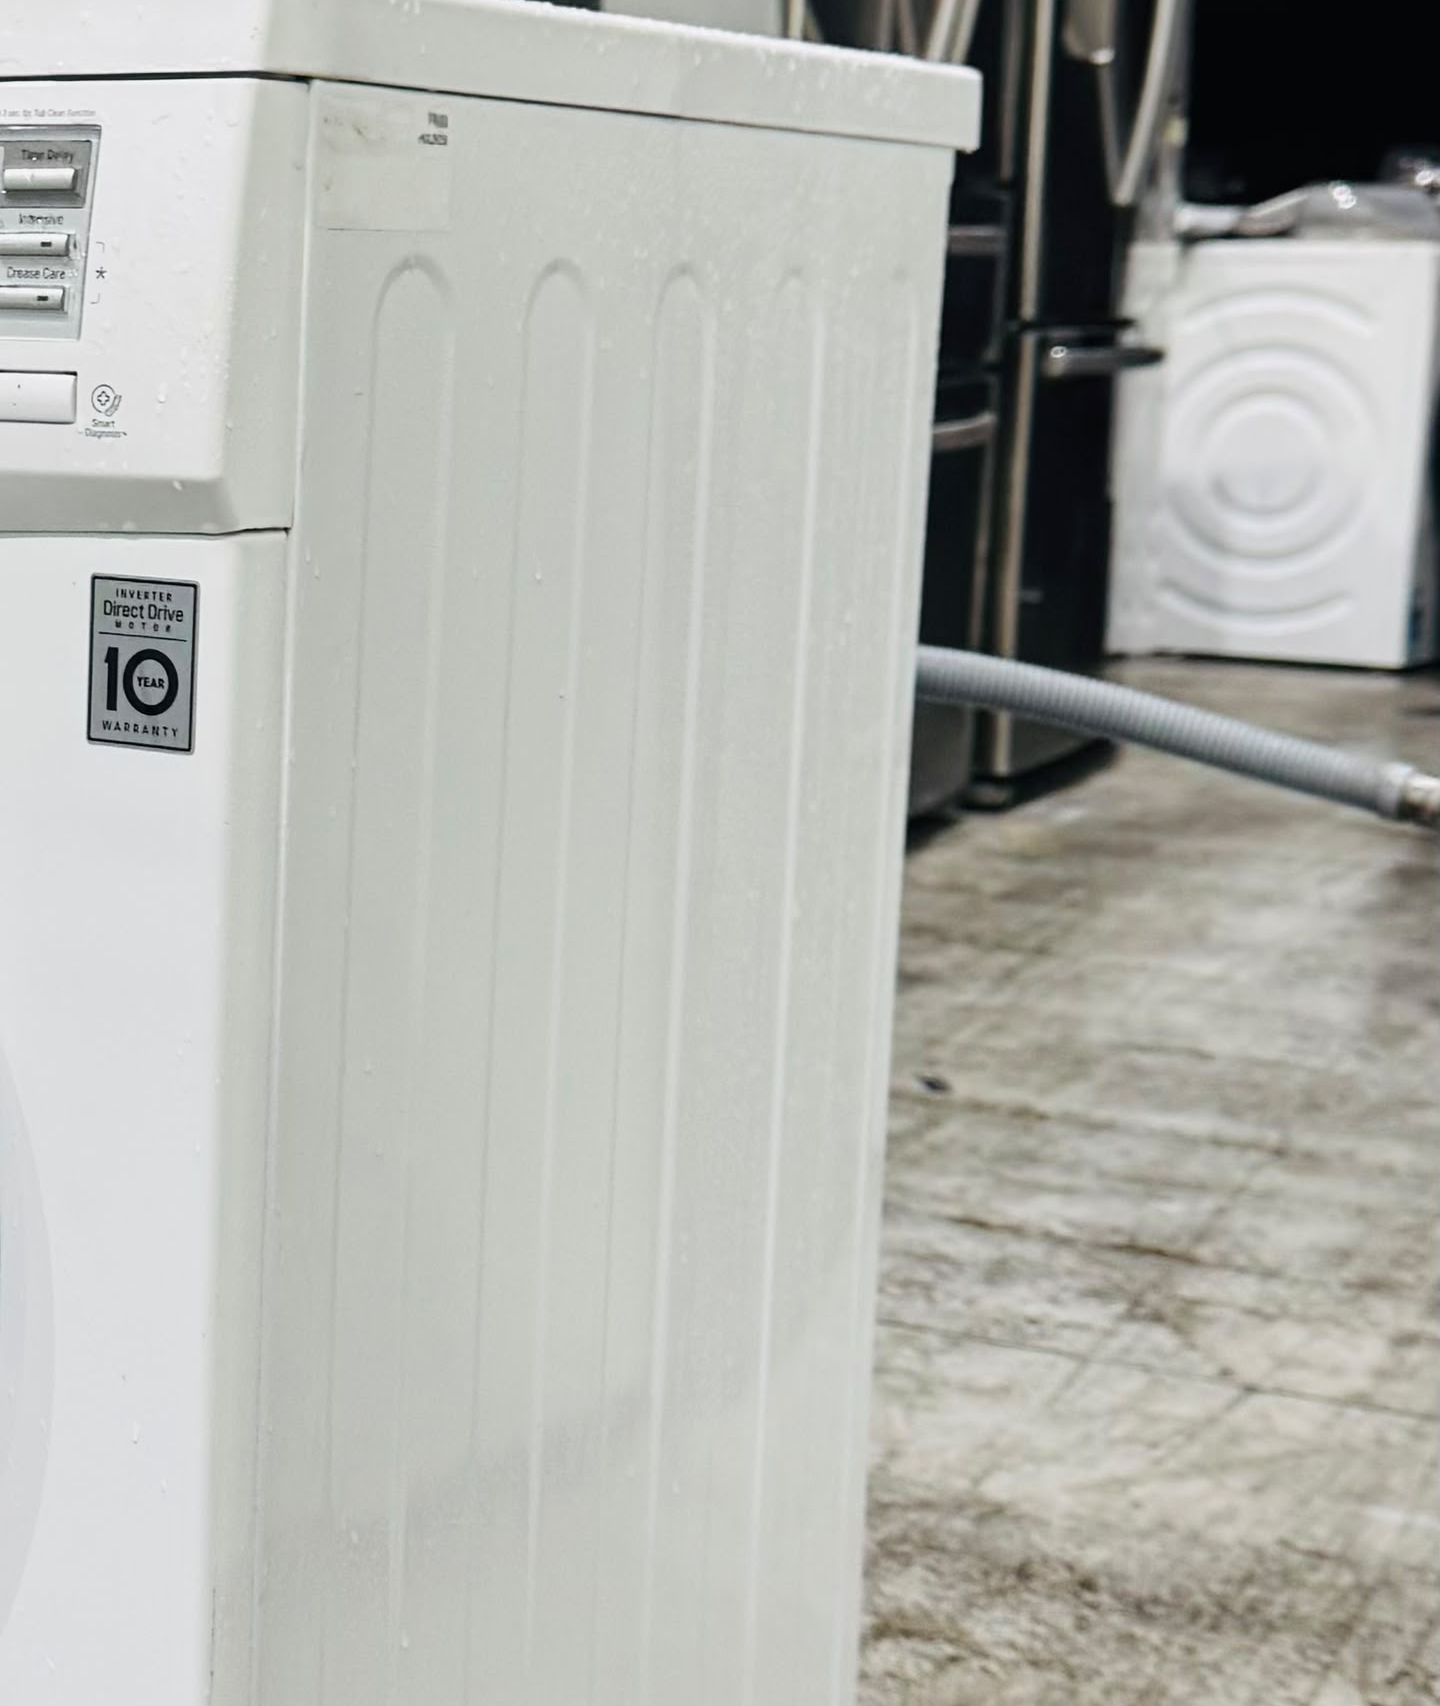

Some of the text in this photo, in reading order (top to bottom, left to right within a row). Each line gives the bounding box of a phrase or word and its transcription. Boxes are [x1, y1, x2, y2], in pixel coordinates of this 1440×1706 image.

[43, 268, 65, 279] Care
[116, 588, 172, 602] INVERTER
[103, 600, 184, 623] Direct Drive
[104, 646, 179, 717] 10
[137, 676, 165, 690] YEAR
[102, 720, 179, 738] WARRANTY
